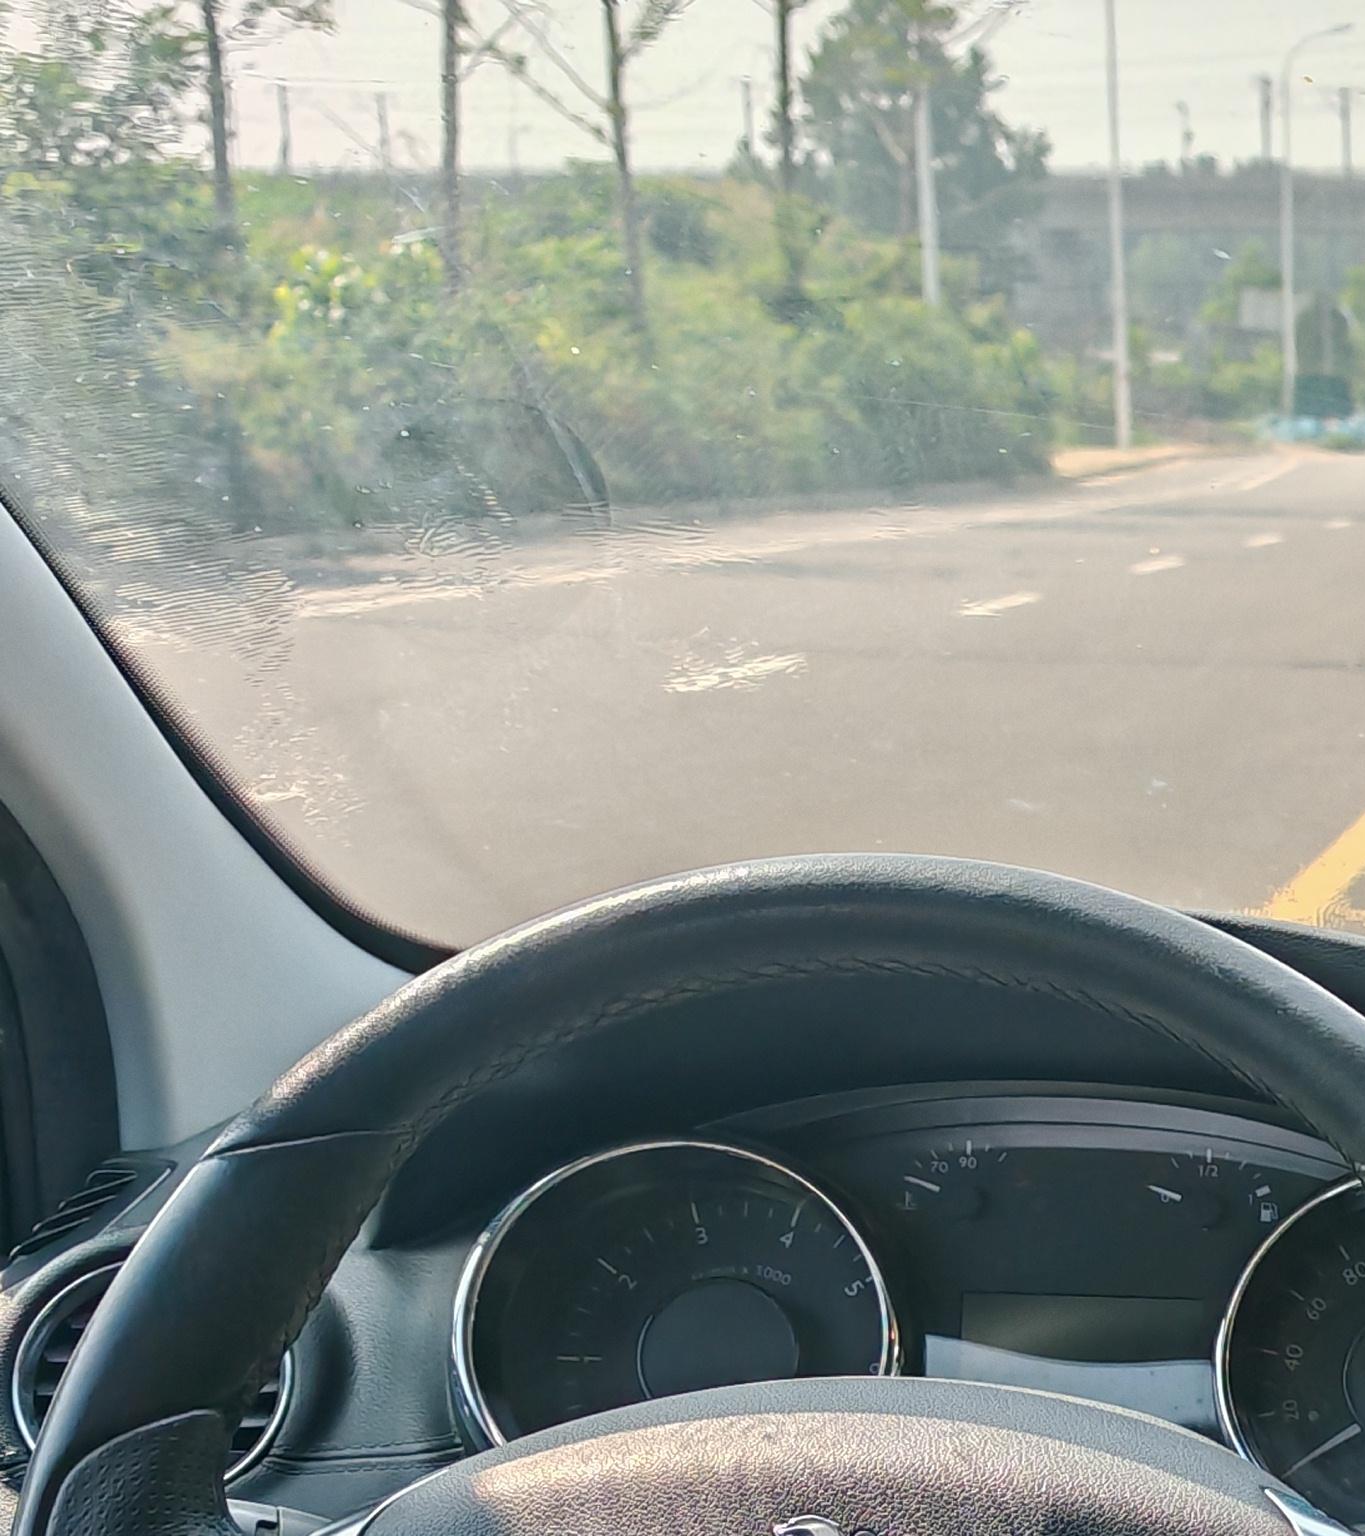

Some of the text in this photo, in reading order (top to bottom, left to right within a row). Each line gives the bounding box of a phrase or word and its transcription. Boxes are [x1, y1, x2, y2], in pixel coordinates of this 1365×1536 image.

[931, 1161, 949, 1173] 70
[959, 1156, 977, 1169] 90
[1199, 1164, 1219, 1177] 1/2
[695, 1227, 708, 1244] 3
[780, 1231, 794, 1248] 4
[618, 1274, 638, 1290] 2
[756, 1264, 791, 1285] 1000
[844, 1280, 865, 1296] 5
[1306, 1298, 1327, 1320] 60
[1284, 1344, 1303, 1371] 40
[1283, 1399, 1299, 1421] 20
